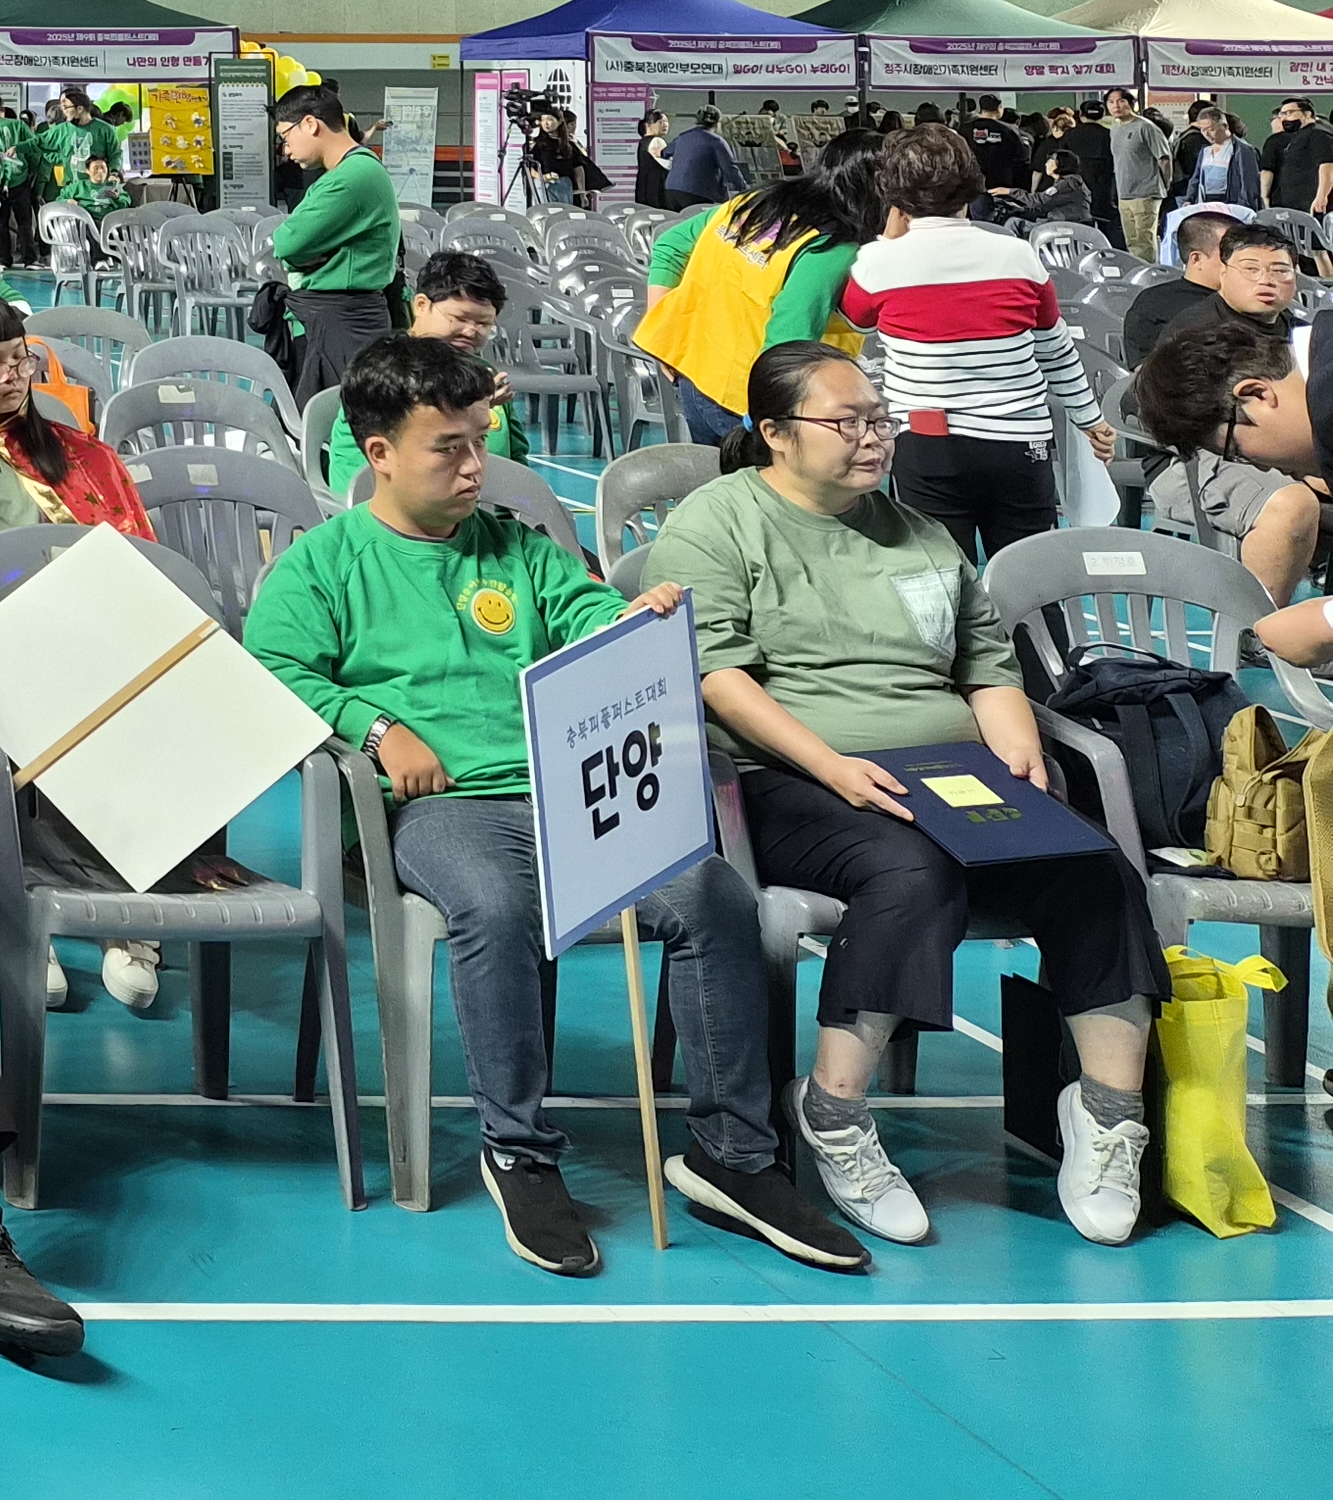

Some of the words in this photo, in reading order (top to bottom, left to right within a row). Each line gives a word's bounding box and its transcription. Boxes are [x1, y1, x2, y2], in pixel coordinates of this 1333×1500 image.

[47, 33, 74, 41] 2025년
[127, 57, 157, 67] 나만의
[160, 56, 180, 67] 인형
[1095, 63, 1115, 74] 대회
[565, 675, 668, 750] 충북피플퍼스트대회
[580, 721, 664, 842] 단양
